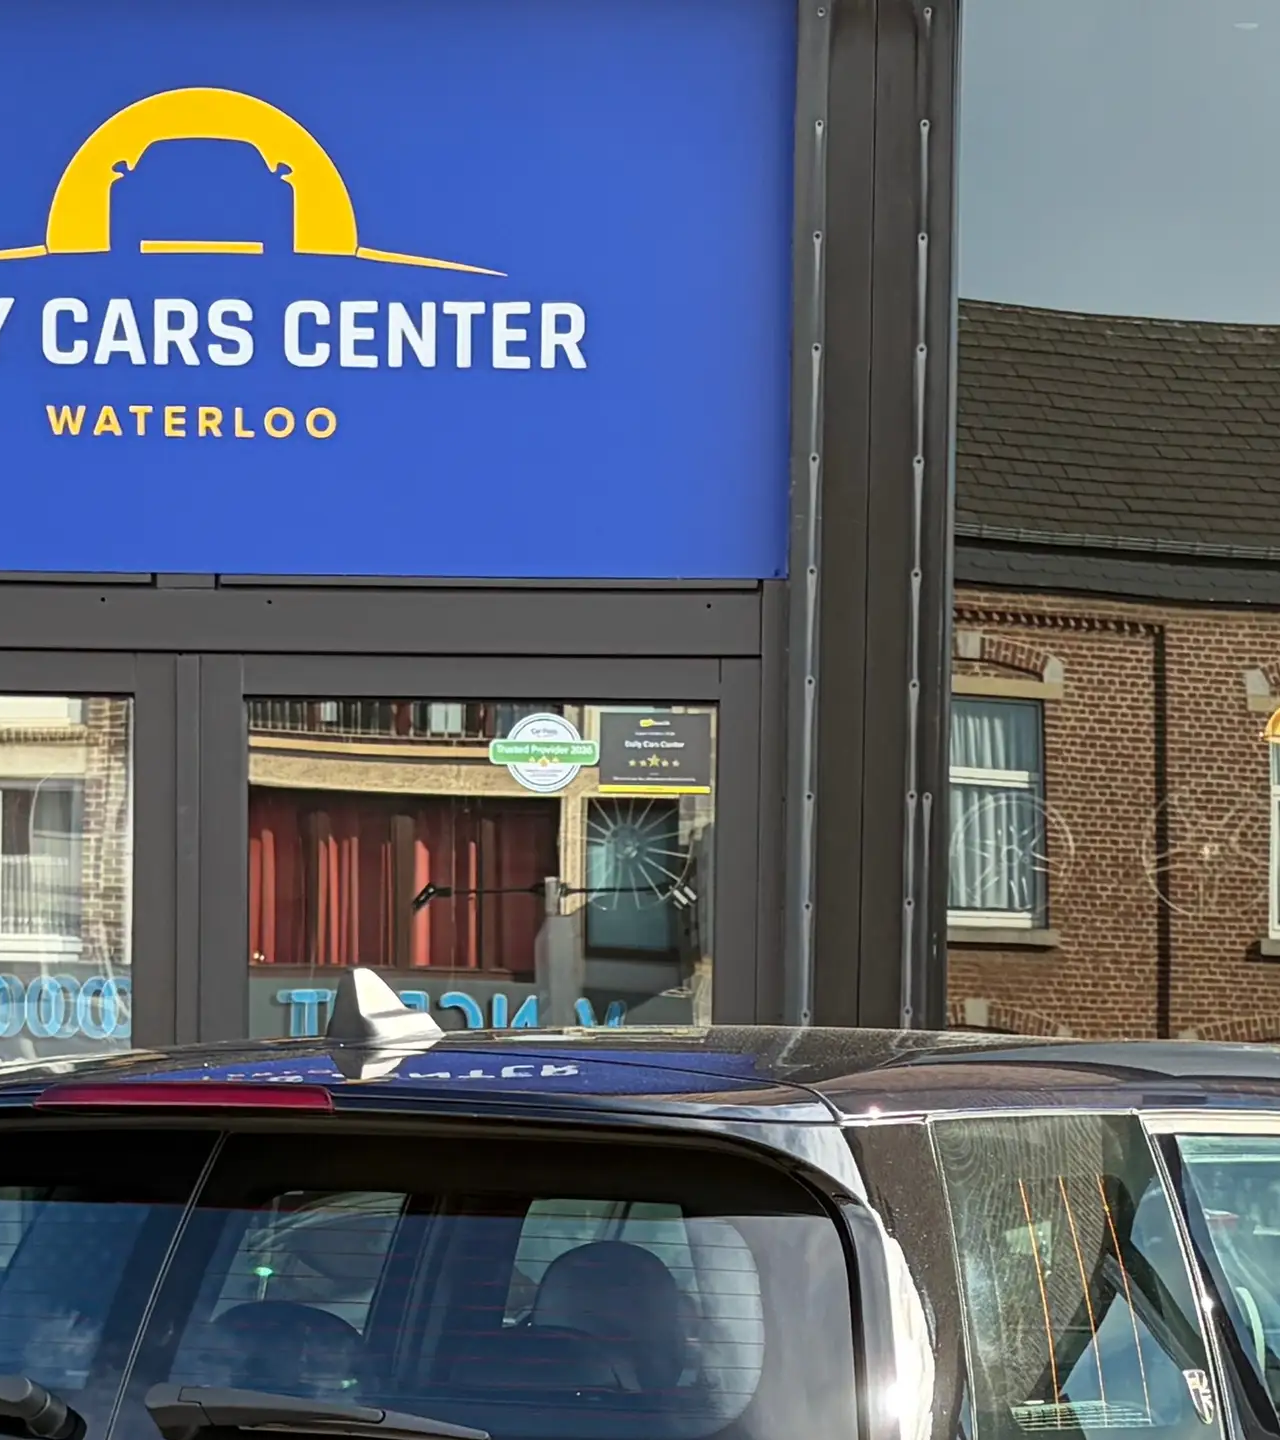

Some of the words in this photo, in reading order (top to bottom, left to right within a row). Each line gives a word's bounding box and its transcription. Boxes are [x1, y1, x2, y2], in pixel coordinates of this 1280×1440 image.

[42, 297, 256, 368] CARS
[284, 300, 589, 371] CENTER
[46, 404, 339, 440] WATERLOO
